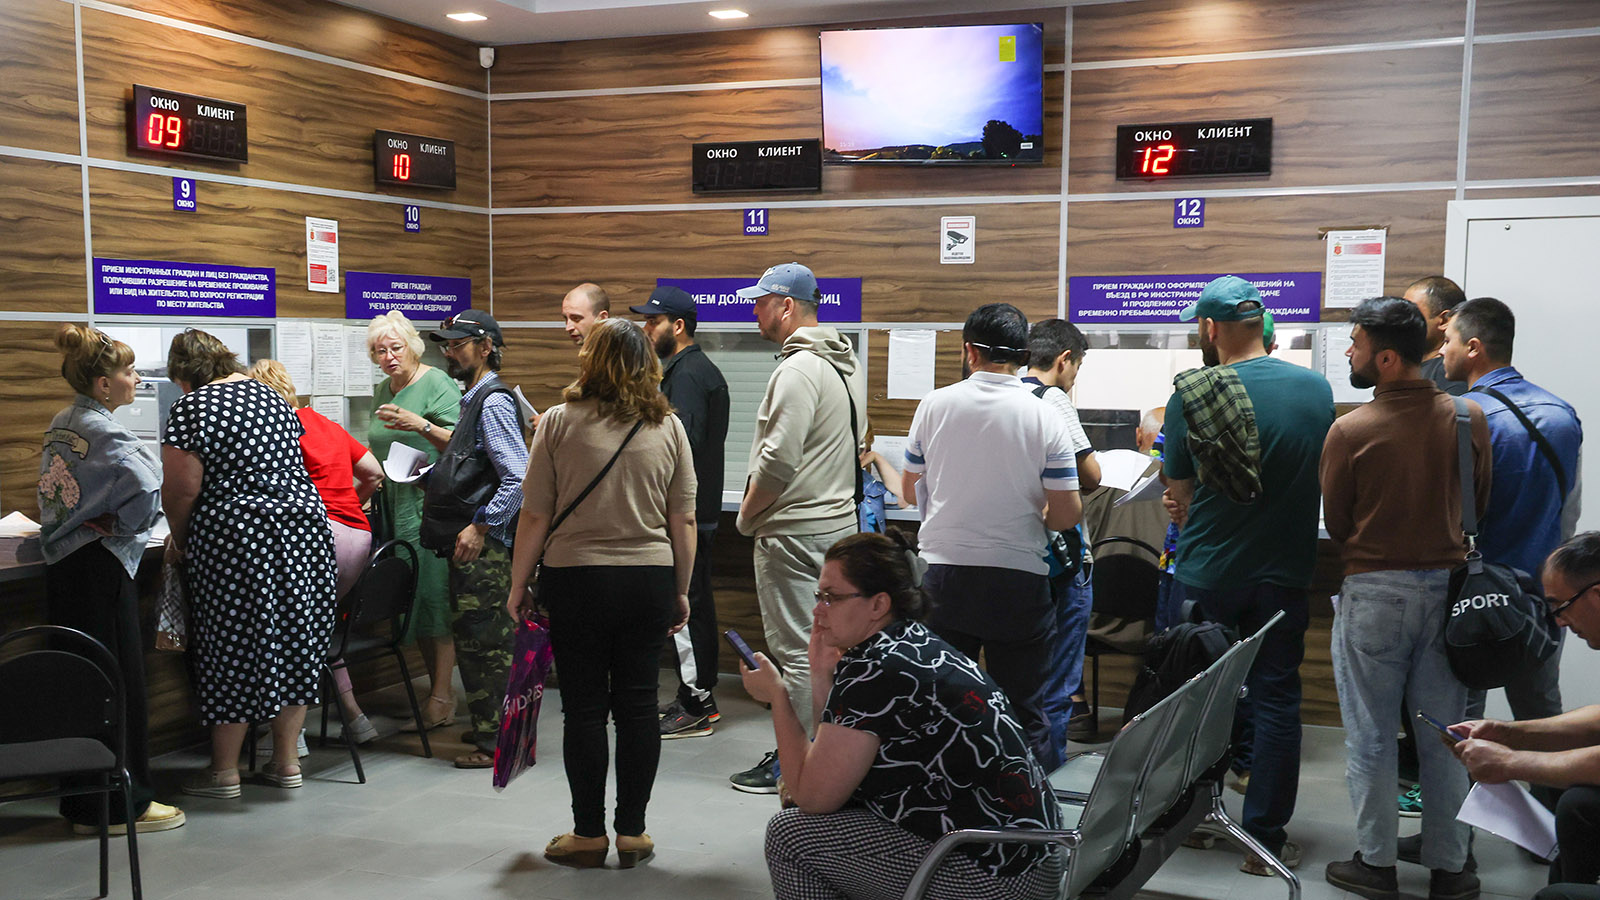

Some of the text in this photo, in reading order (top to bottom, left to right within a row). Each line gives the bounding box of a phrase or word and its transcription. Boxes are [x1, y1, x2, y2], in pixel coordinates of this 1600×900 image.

[150, 96, 234, 120] ОКНО КЛИЕНТ
[148, 113, 181, 147] 09
[1135, 126, 1252, 142] ОКНО КЛИЕНТ
[388, 139, 446, 155] ОКНО КЛИЕНТ
[707, 146, 802, 158] ОКНО КЛИЕНТ
[1142, 145, 1174, 173] 12
[394, 154, 410, 180] 10
[181, 180, 190, 198] 9
[407, 206, 418, 221] 10
[1178, 199, 1200, 216] 12
[748, 210, 764, 224] 11
[102, 265, 124, 273] ПРИЕМ
[126, 267, 171, 276] ИНОСТРАННЫХ
[172, 270, 199, 278] ГРАЖДАН
[206, 271, 217, 279] ЛИЦ
[103, 276, 146, 285] ПОЛУЧИВШИХ
[148, 279, 187, 287] РАЗРЕШЕНИЕ
[124, 288, 137, 296] ВИД
[200, 291, 226, 299] ВОПРОСУ
[227, 292, 264, 300] РЕГИСТРАЦИИ
[372, 292, 416, 300] ОСУЩЕСТВЛЕНИЮ
[692, 294, 716, 304] ИЕМ
[718, 294, 756, 305] ДОЛЖ
[391, 302, 423, 311] РОССИЙСКОЙ
[1452, 593, 1509, 616] SPORT
